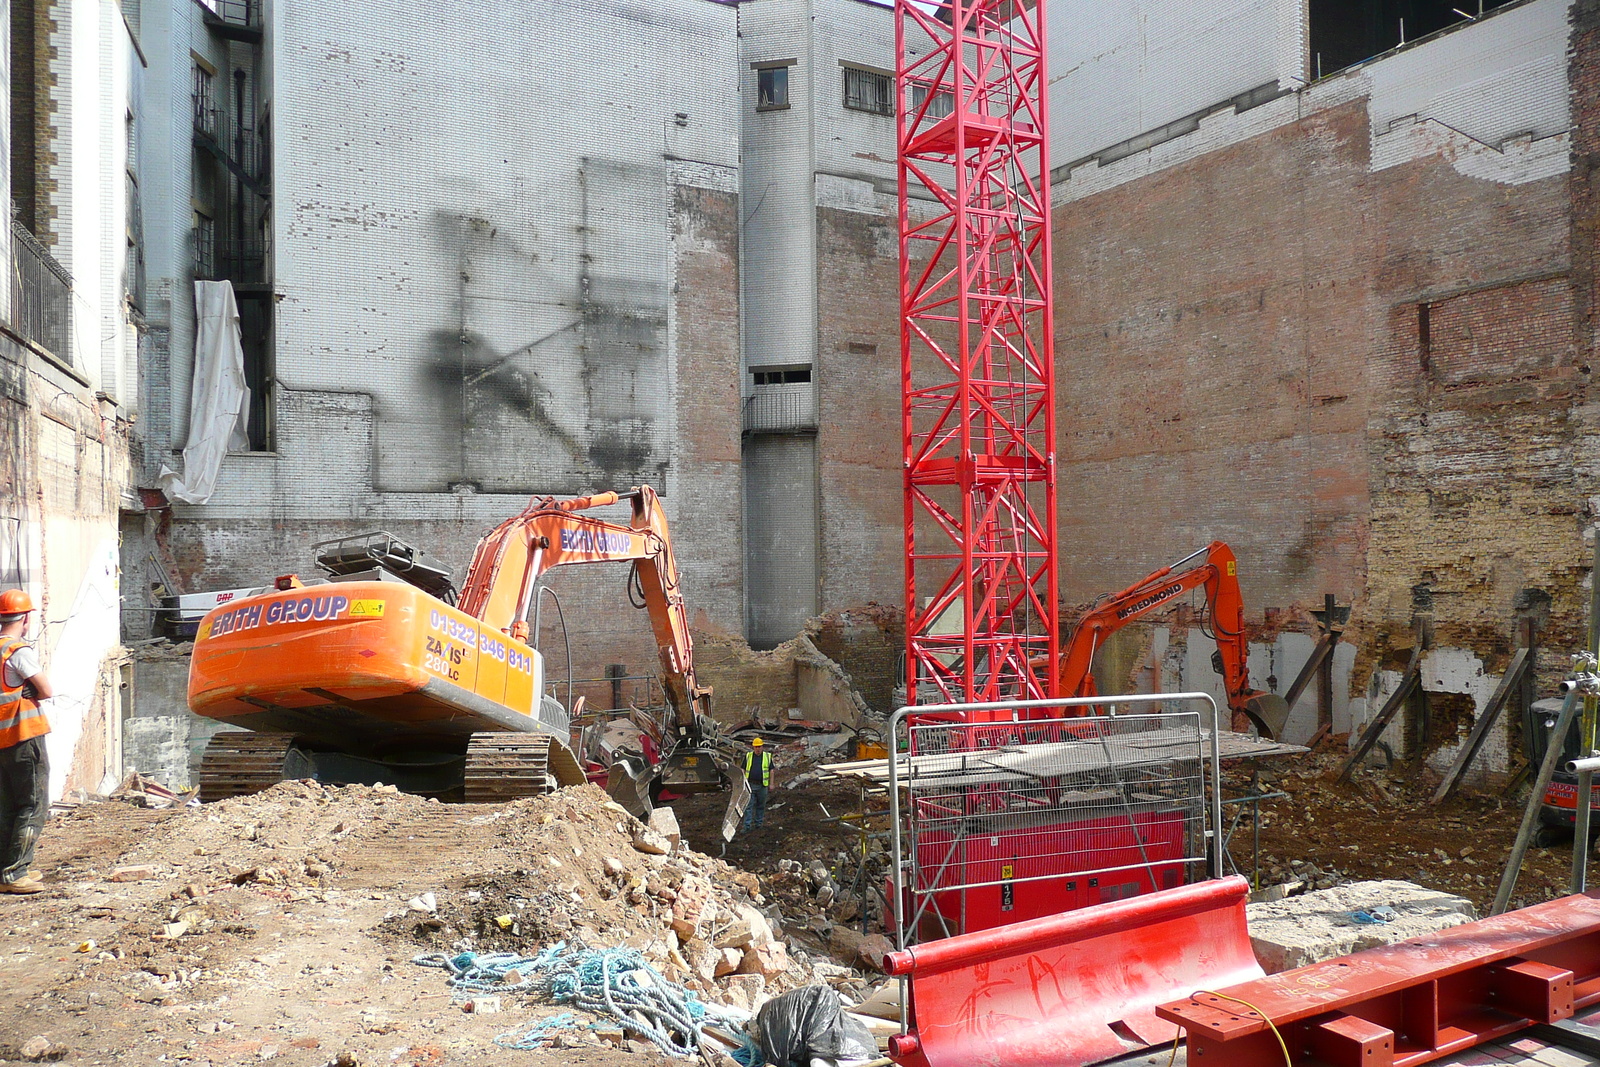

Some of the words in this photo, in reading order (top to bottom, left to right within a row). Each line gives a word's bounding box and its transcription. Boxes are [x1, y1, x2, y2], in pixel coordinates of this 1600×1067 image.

[560, 528, 594, 553] ERITH
[596, 531, 632, 555] GROUP
[209, 603, 263, 640] ERITH
[265, 595, 348, 626] GROUP
[426, 635, 461, 664] ZAXIS
[430, 609, 476, 648] 01322
[480, 633, 506, 662] 346
[508, 648, 531, 676] 811
